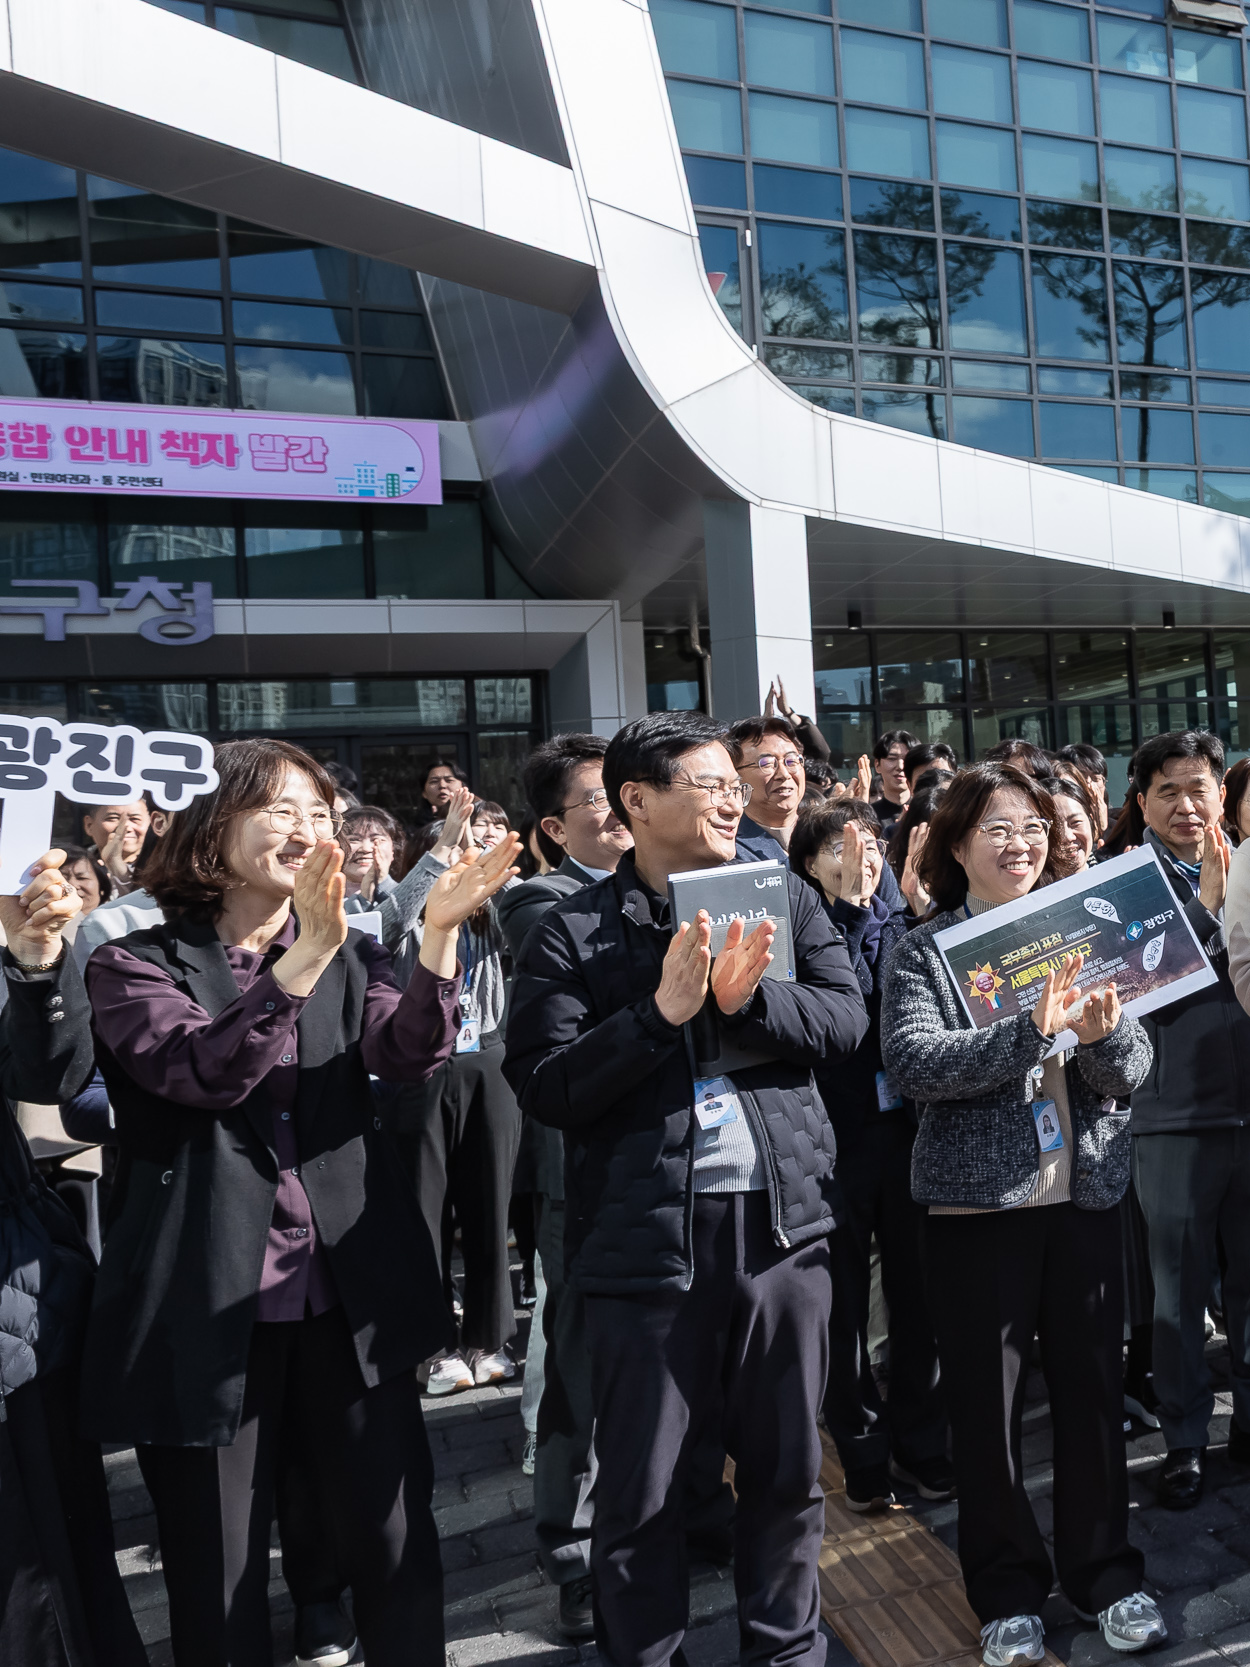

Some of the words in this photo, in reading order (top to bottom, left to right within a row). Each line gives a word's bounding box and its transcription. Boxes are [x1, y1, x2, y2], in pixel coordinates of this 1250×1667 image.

[64, 426, 149, 464] 안내
[160, 430, 239, 468] 책자
[248, 433, 330, 473] 발간
[117, 476, 163, 487] 주민센터
[0, 576, 215, 646] 구청
[0, 724, 208, 801] 광진구
[1143, 909, 1175, 930] 광진구
[1000, 941, 1043, 967] 국무총리
[1040, 931, 1063, 951] 표창
[1010, 956, 1061, 990] 서울특별시
